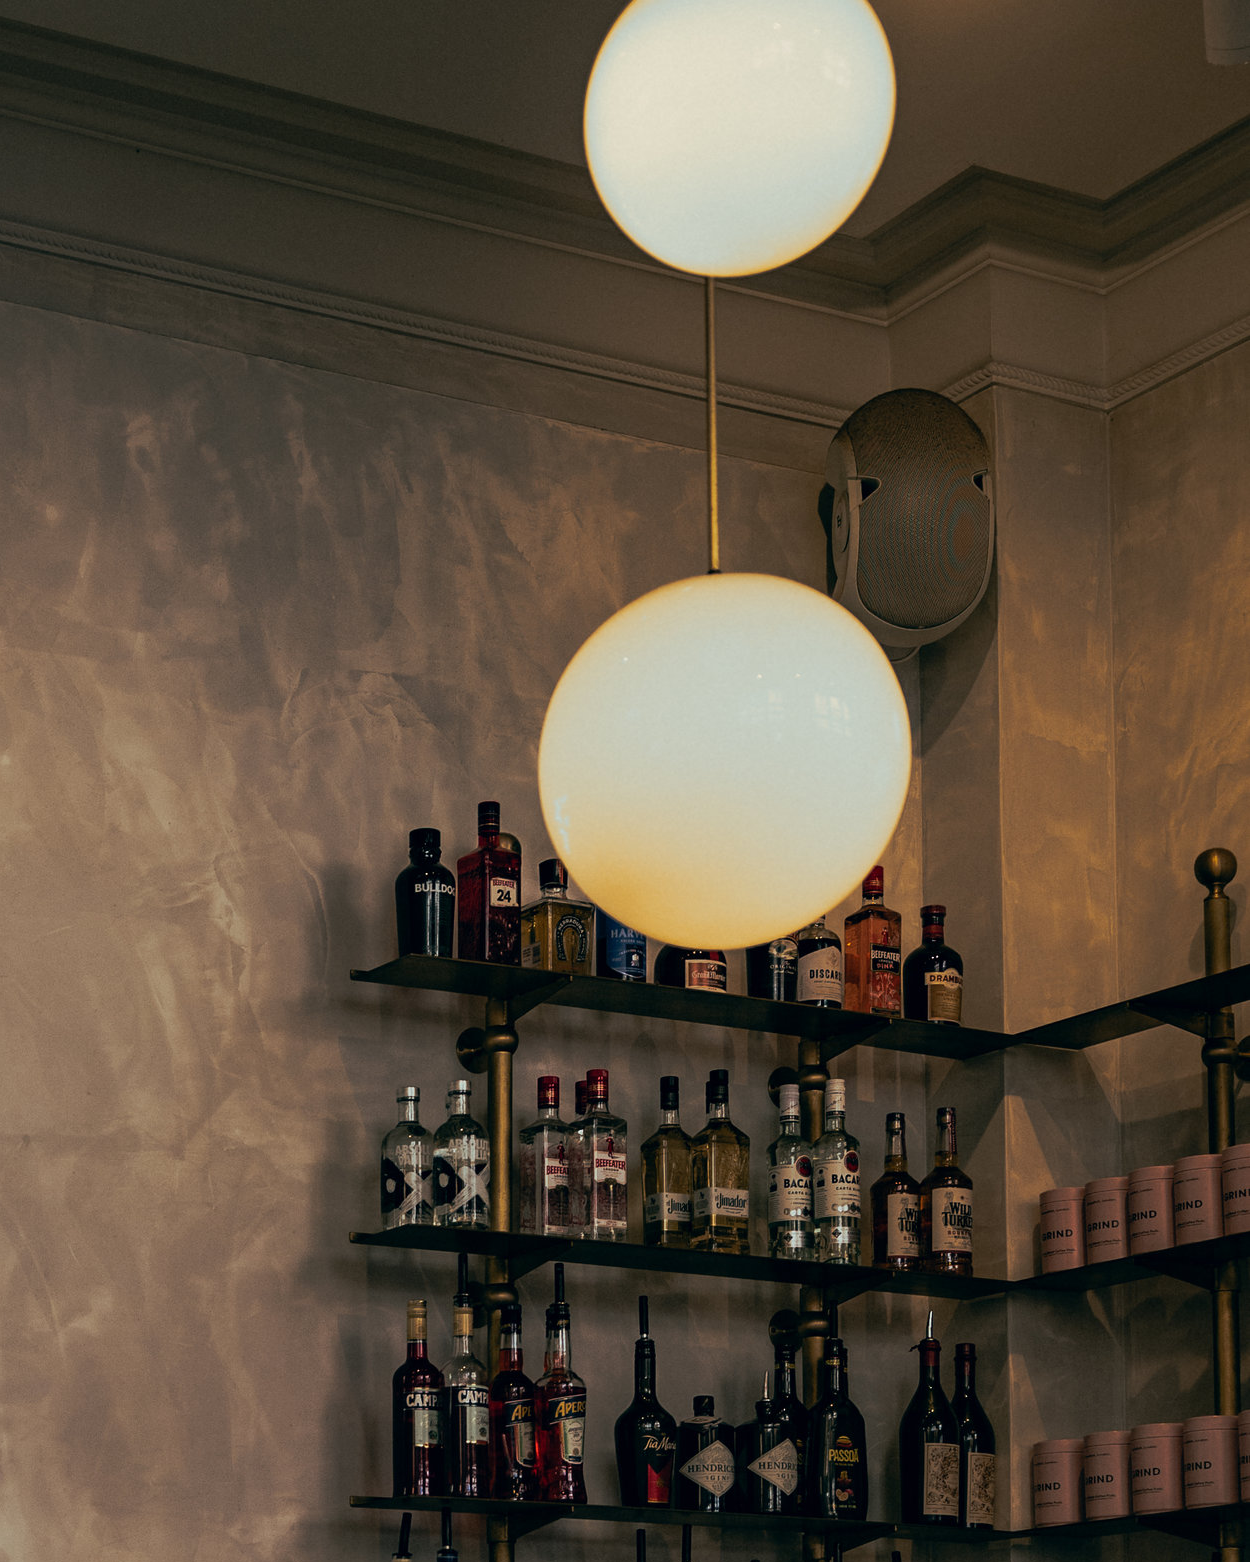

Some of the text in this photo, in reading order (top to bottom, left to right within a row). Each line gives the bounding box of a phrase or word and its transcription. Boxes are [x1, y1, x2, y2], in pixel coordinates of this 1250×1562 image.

[496, 889, 511, 903] 24
[870, 948, 901, 963] BEEFEATER
[595, 1158, 627, 1171] BEEFEATER
[716, 1192, 747, 1209] Jimador
